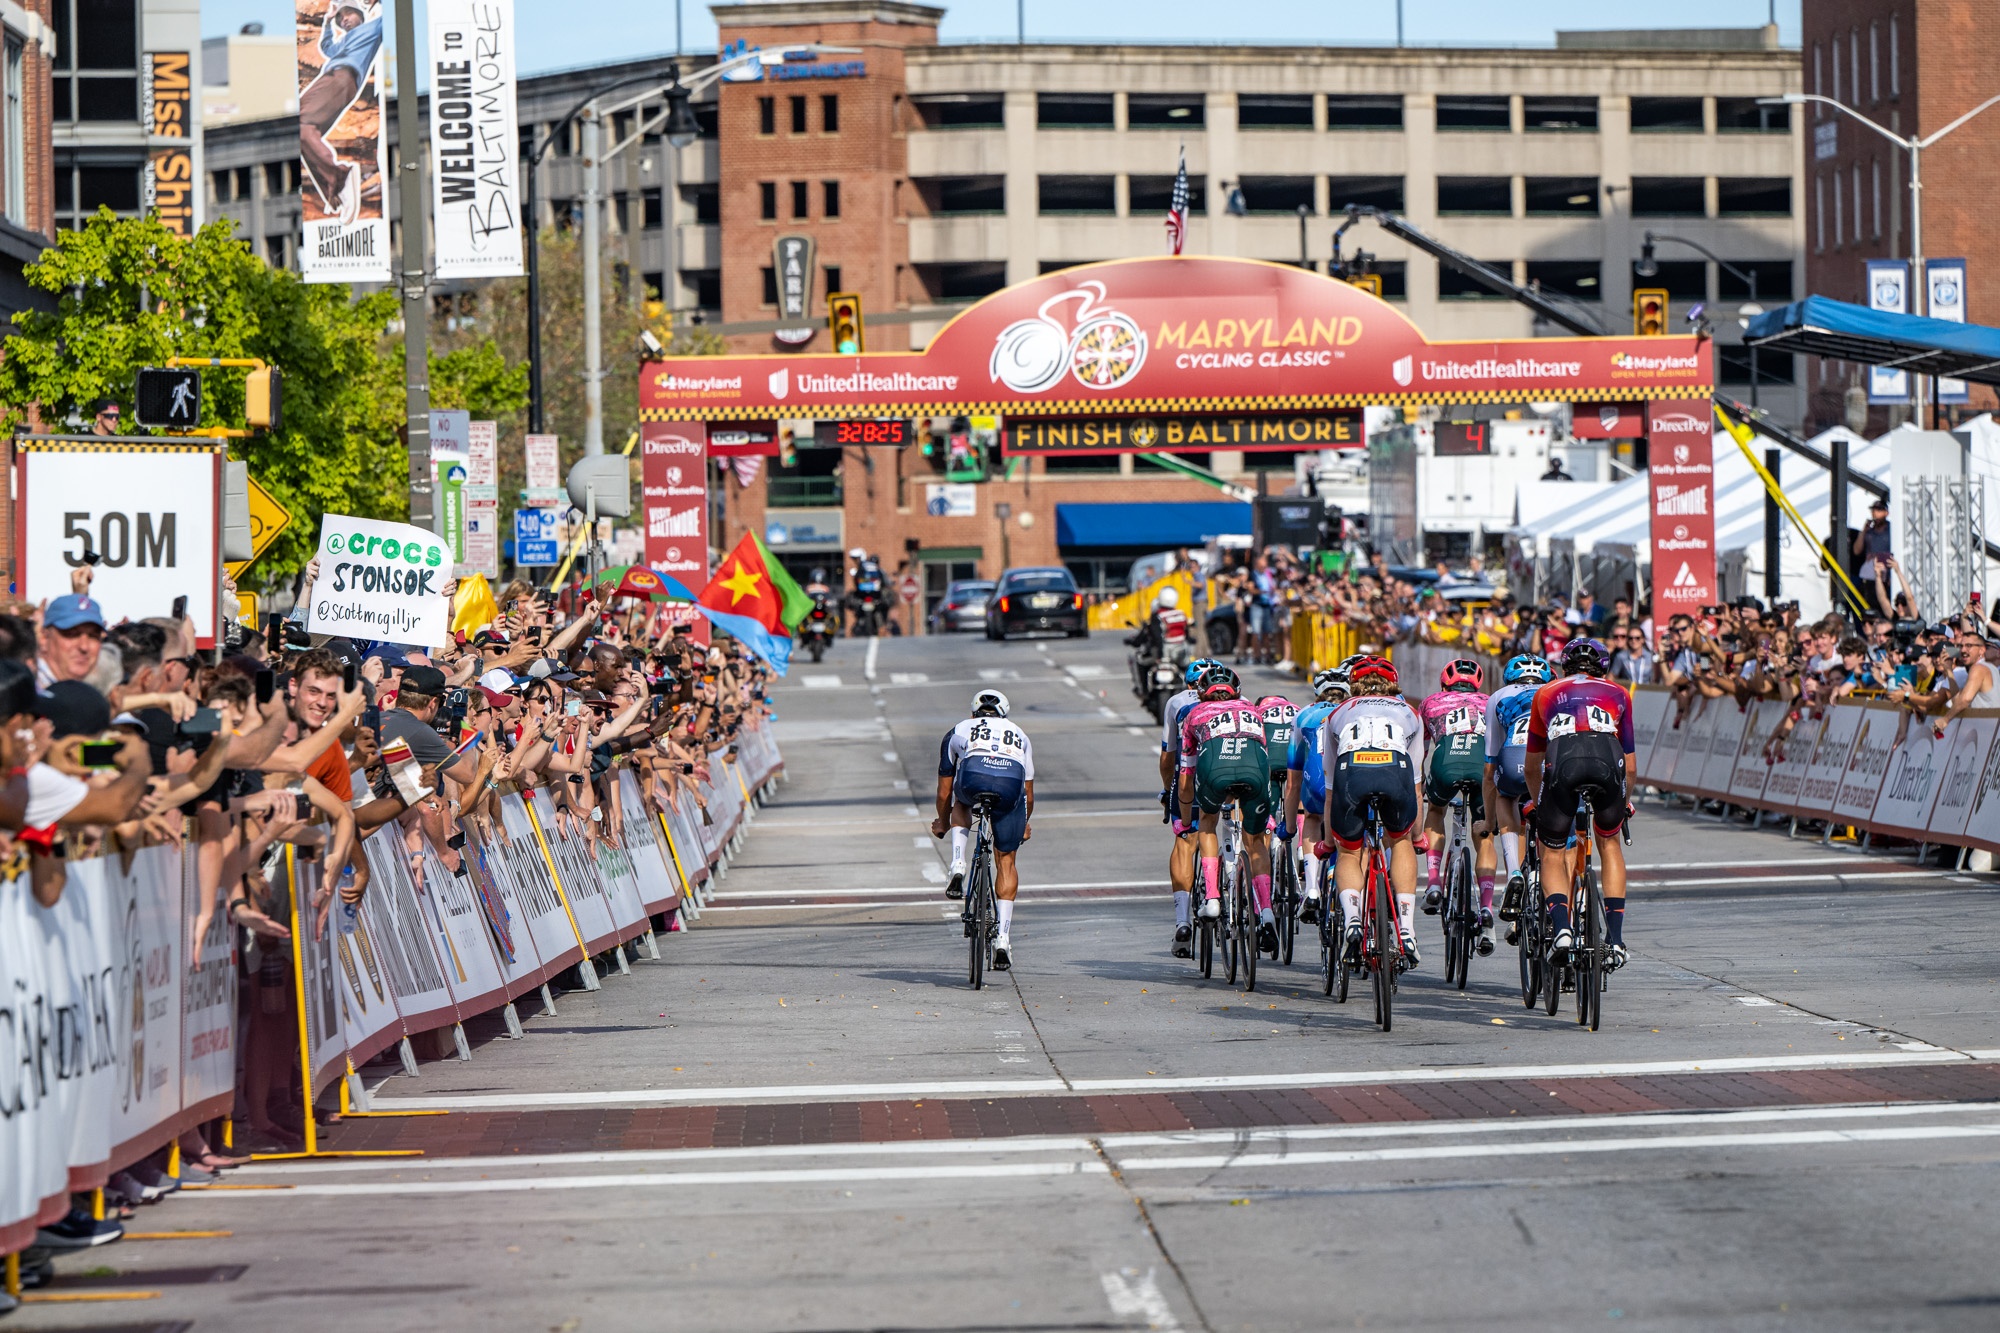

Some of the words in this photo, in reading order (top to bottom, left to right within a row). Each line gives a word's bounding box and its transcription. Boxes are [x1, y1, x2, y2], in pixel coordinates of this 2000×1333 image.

[444, 31, 463, 52] TO
[153, 53, 190, 137] Miss
[469, 2, 513, 244] BALTIMORE
[437, 60, 476, 205] WELCOME
[317, 225, 342, 241] VISIT
[318, 225, 376, 258] BALTIMORE
[785, 239, 803, 313] PARK
[1154, 316, 1363, 350] MARYLAND
[1175, 352, 1254, 369] CYCLING
[1258, 350, 1332, 367] CLASSIC
[1633, 354, 1698, 371] Maryland
[1421, 358, 1581, 380] UnitedHealthcare
[678, 375, 742, 391] Maryland
[797, 372, 959, 393] UnitedHealthcare
[438, 419, 450, 431] NO
[1016, 422, 1122, 447] FINISH
[1167, 416, 1351, 445] BALTIMORE
[1652, 418, 1710, 435] DirectPay
[1465, 424, 1484, 451] 4
[644, 440, 703, 456] DirectPay
[1652, 464, 1675, 475] Kelly
[1676, 463, 1712, 474] Benefits
[645, 486, 667, 497] Kelly
[668, 485, 705, 496] Benefits
[1656, 485, 1679, 501] VISIT
[1656, 485, 1708, 516] BALTIMORE
[446, 491, 456, 531] HARBOR
[649, 507, 672, 523] VISIT
[649, 507, 701, 538] BALTIMORE
[326, 533, 442, 567] @crocs
[526, 543, 547, 552] PAY
[522, 553, 552, 562] HERE
[332, 562, 437, 597] SPONSOR
[1663, 588, 1708, 599] ALLEGIS
[1208, 712, 1232, 729] 34
[1241, 711, 1262, 728] 34
[1448, 708, 1466, 725] 31
[1552, 714, 1571, 727] 47
[1591, 706, 1610, 725] 47
[1350, 723, 1359, 740] 1
[1385, 723, 1393, 740] 1
[1516, 718, 1530, 734] 2
[970, 727, 991, 743] 83
[1002, 729, 1023, 749] 83
[1451, 734, 1477, 749] EF
[1220, 738, 1247, 754] EF
[1356, 753, 1389, 762] PIRELLI
[1888, 750, 1938, 818] DirectPay
[545, 824, 600, 902] THORNE
[500, 831, 562, 921] THORNE
